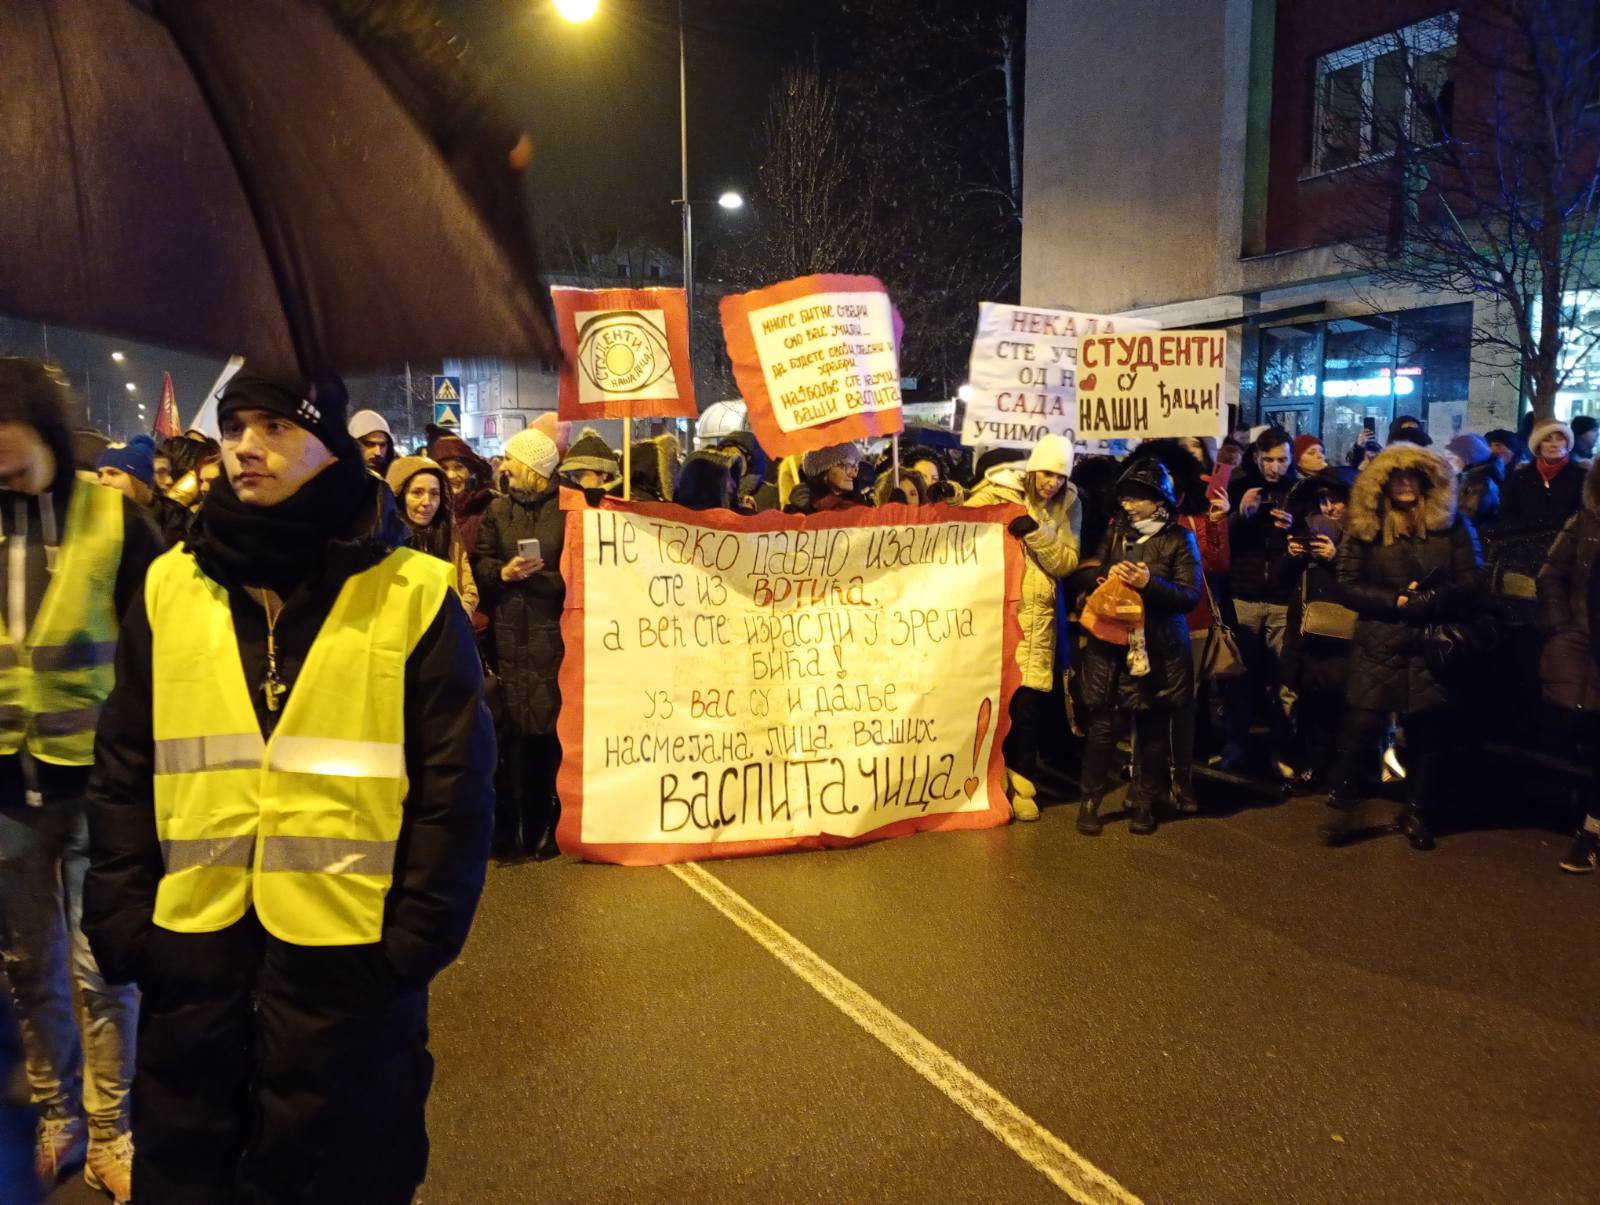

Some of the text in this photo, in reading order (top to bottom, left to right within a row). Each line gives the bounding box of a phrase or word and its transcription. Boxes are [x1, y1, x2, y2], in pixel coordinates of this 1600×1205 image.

[596, 330, 642, 380] СТУДЕНТИ
[997, 340, 1035, 361] СТЕ
[1083, 336, 1224, 372] СТУДЕНТИ
[1019, 367, 1048, 389] ОД
[1118, 373, 1138, 391] СУ
[997, 391, 1065, 419] САДА
[1080, 397, 1148, 431] НАШИ
[597, 512, 638, 566] Не
[747, 529, 850, 579] давно
[866, 524, 978, 569] изашли
[649, 574, 685, 607] сте
[697, 575, 727, 606] из
[603, 608, 977, 650] а већ сте израсли у зрела
[644, 690, 674, 719] уз
[749, 688, 772, 717] су
[788, 687, 803, 712] и
[814, 683, 898, 716] даље
[765, 724, 833, 758] лица
